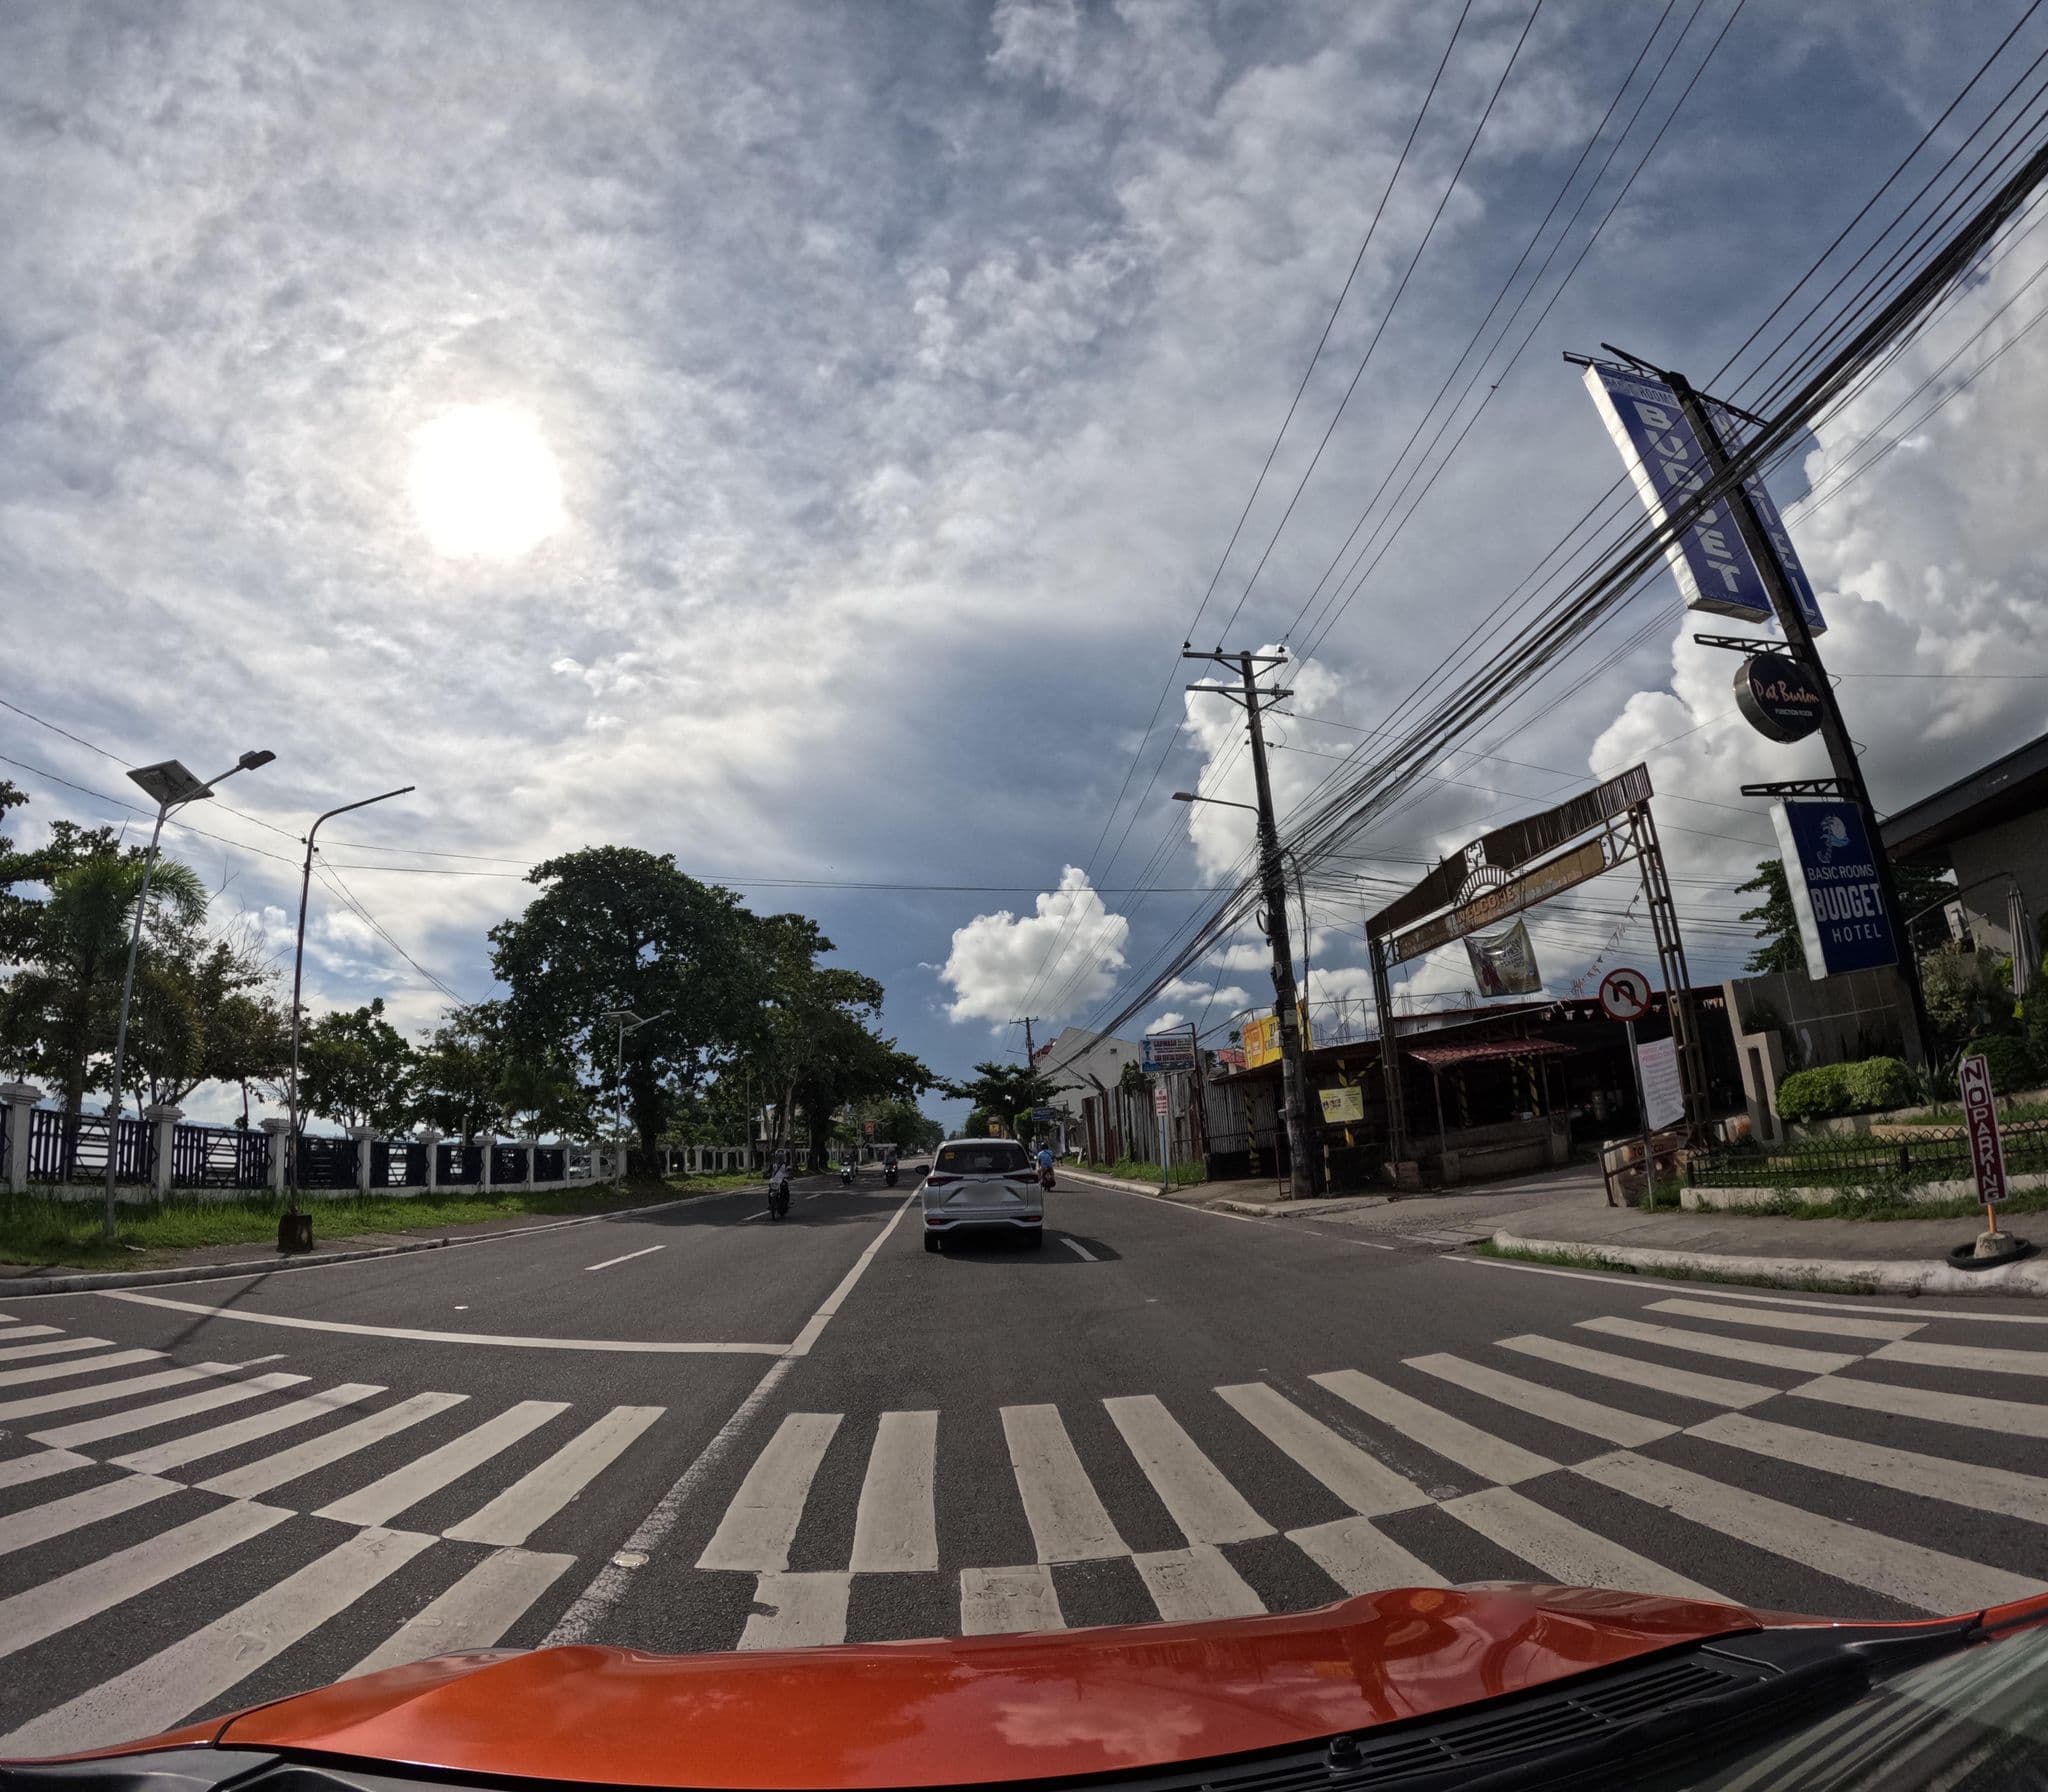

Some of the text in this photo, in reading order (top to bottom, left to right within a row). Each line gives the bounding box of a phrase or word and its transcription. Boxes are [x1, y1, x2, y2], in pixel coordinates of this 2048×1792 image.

[1807, 864, 1874, 881] BASIC ROOMS
[1455, 885, 1515, 924] WELCOME
[1809, 883, 1883, 922] BUDGET
[1832, 922, 1881, 944] HOTEL
[1964, 1062, 1988, 1106] NO
[1973, 1107, 2000, 1202] PARKING
